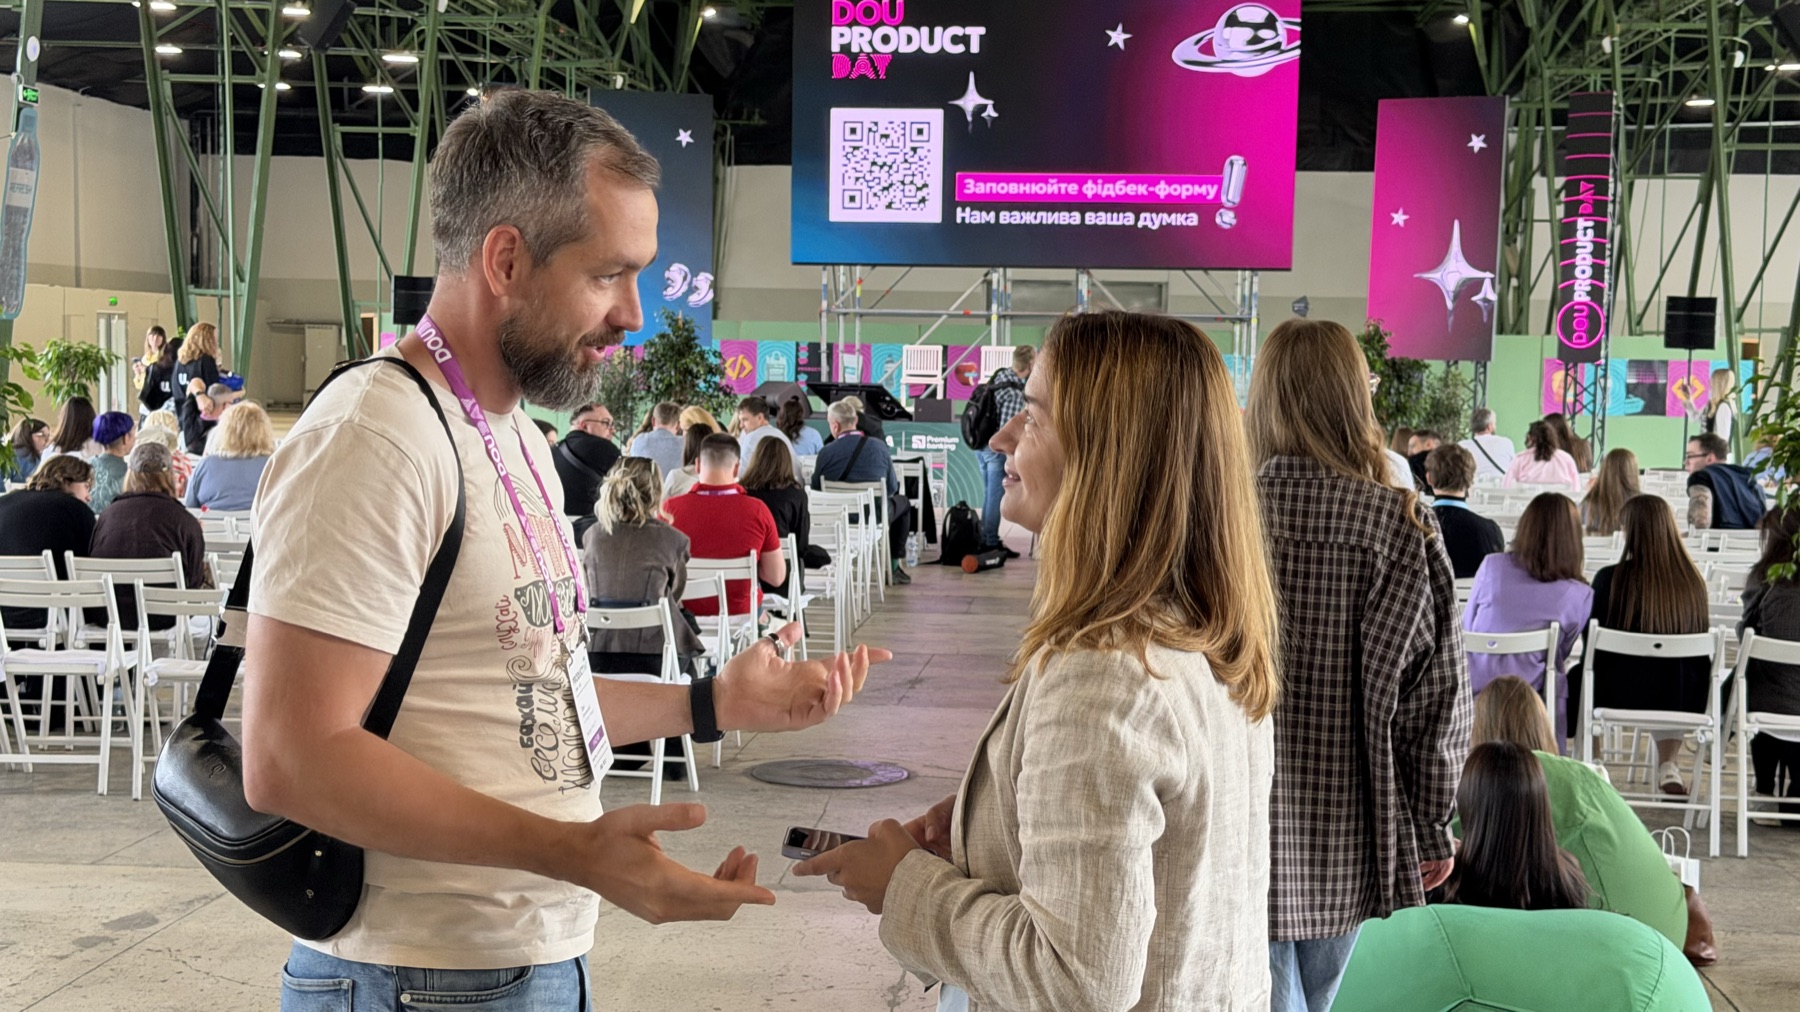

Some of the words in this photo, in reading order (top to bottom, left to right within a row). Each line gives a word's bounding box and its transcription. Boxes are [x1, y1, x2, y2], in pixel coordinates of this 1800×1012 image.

[831, 0, 904, 26] DOU
[831, 26, 986, 54] PRODUCT
[831, 53, 893, 79] DAY
[962, 178, 1079, 195] Заповнюйте
[1081, 178, 1219, 200] фідбек-форму
[1578, 180, 1596, 215] DAY
[955, 206, 996, 224] Нам
[999, 210, 1081, 225] важлива
[1084, 210, 1136, 226] ваша
[1137, 211, 1200, 230] думка
[1573, 217, 1596, 302] PRODUCT
[1572, 305, 1590, 344] DOU
[419, 328, 453, 364] DOU
[926, 435, 960, 444] Premium
[484, 434, 507, 476] DOU
